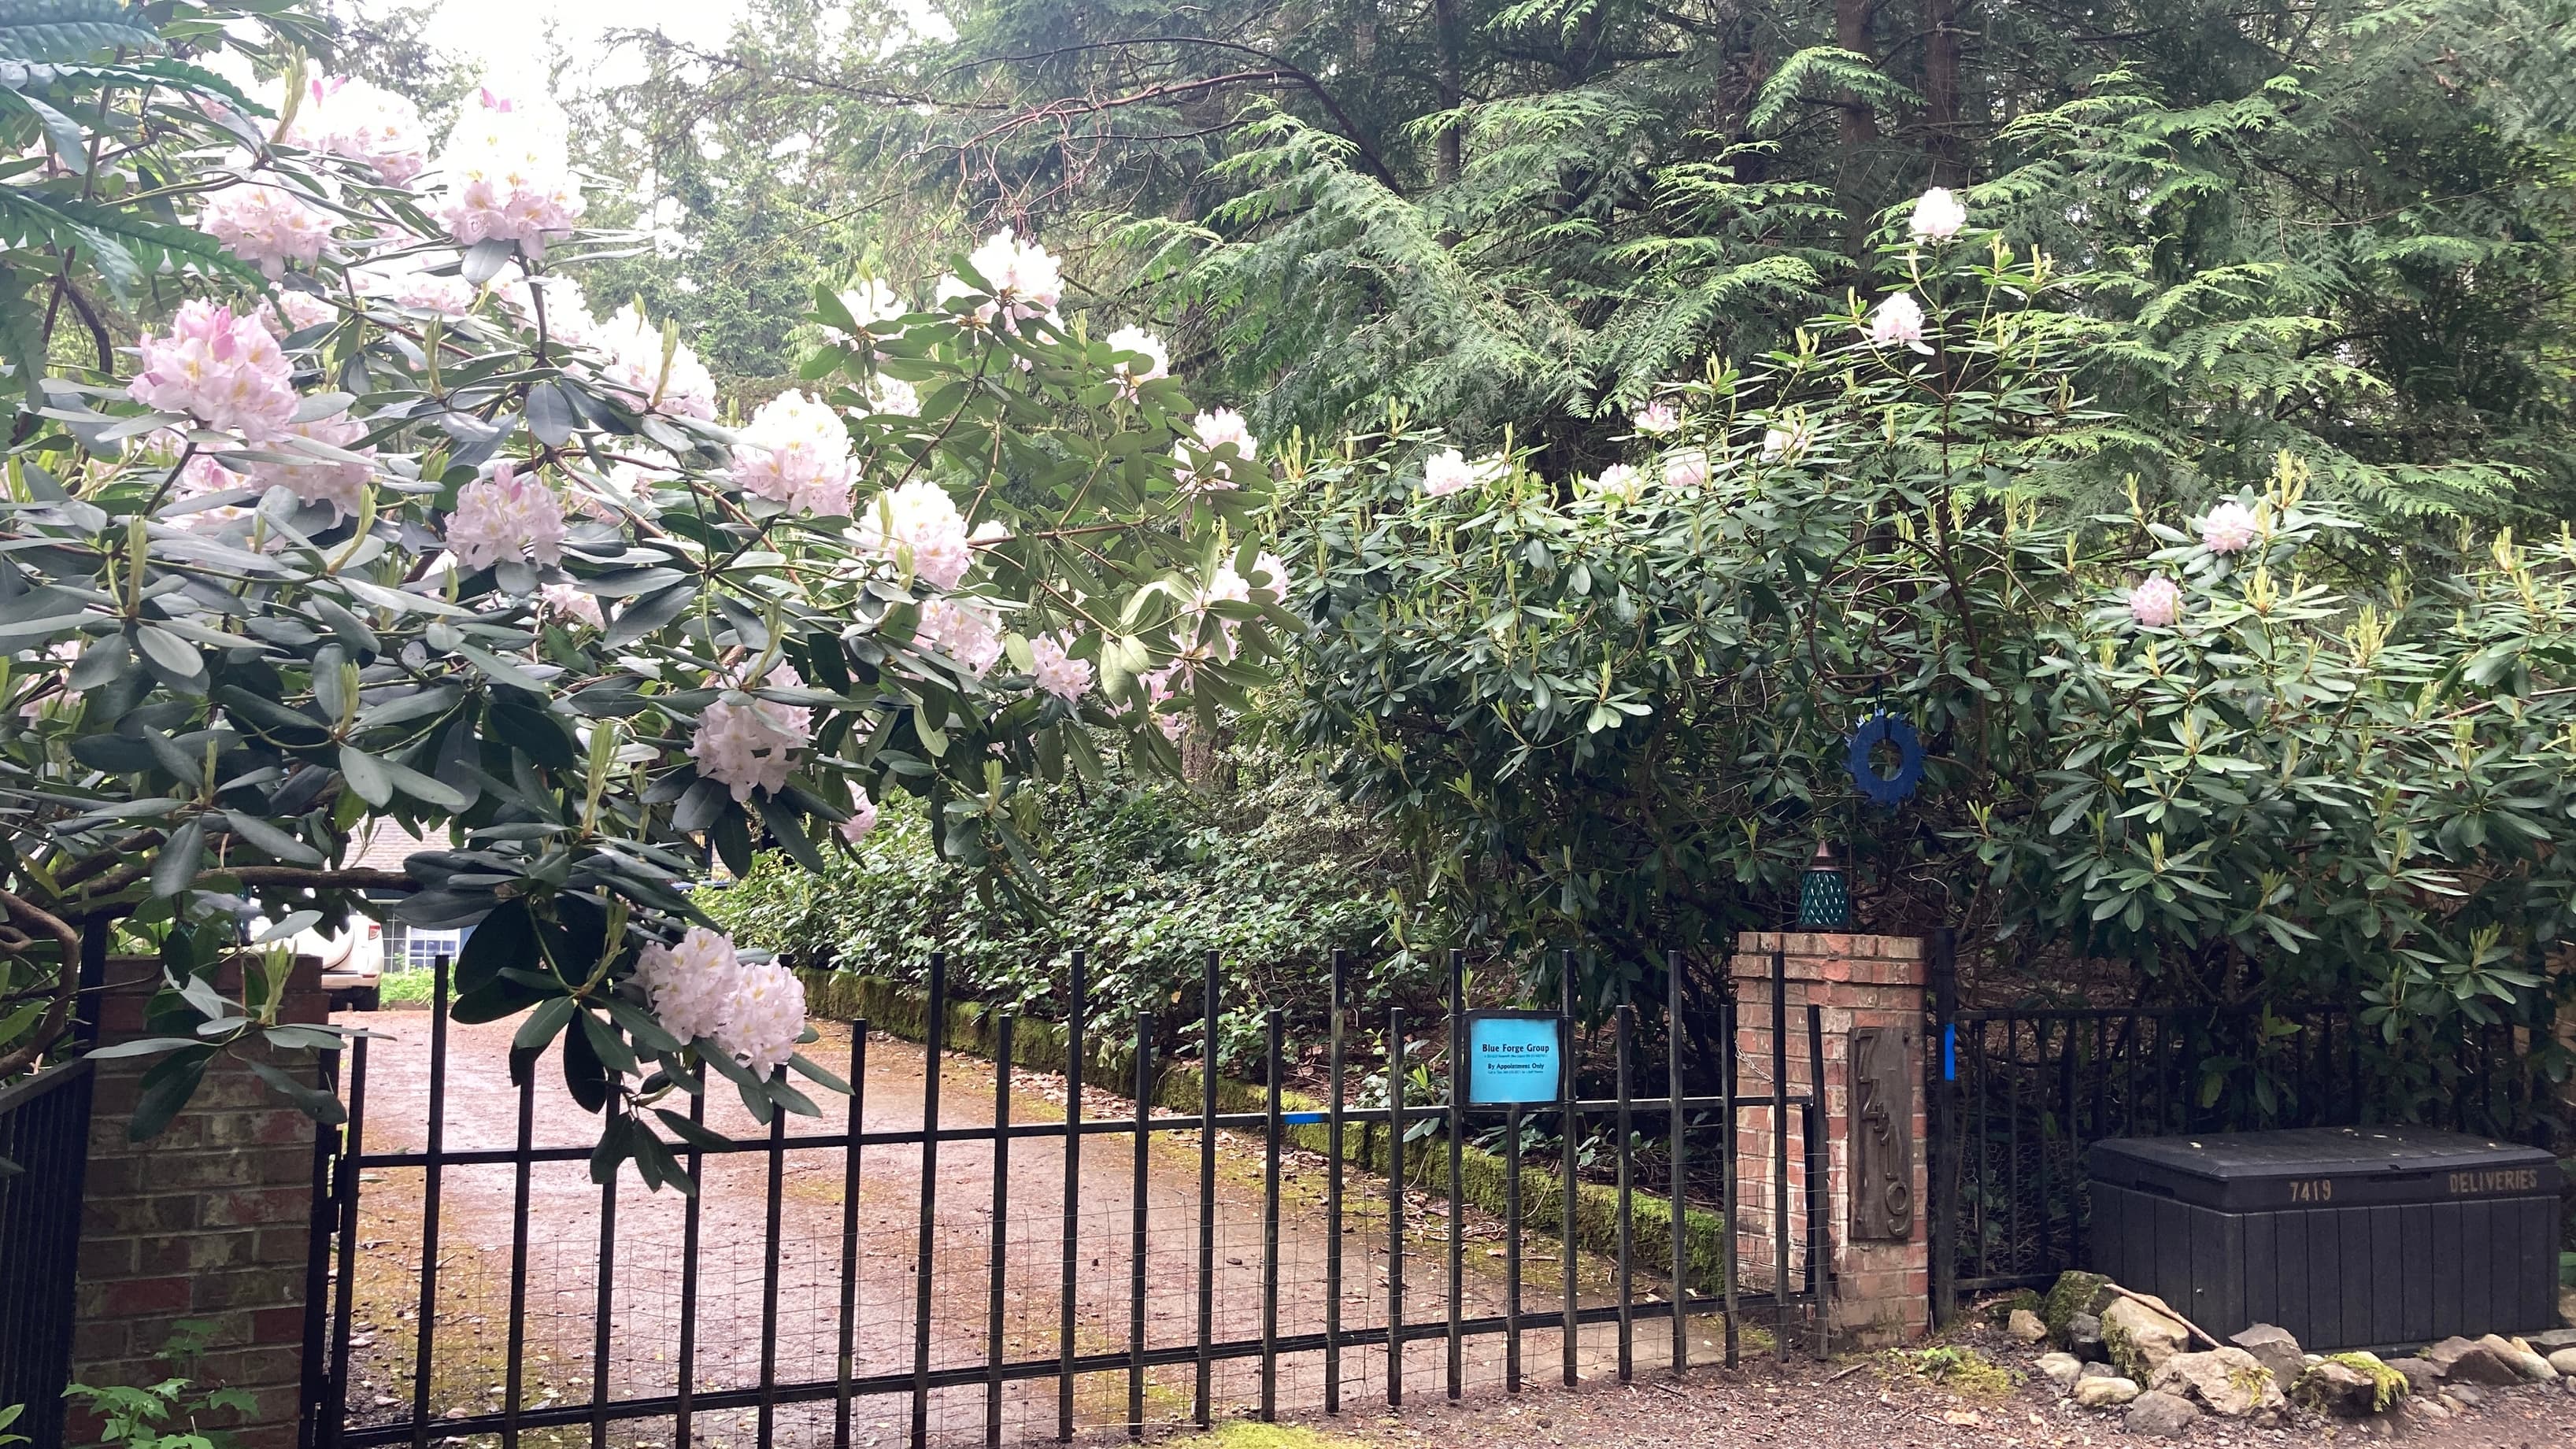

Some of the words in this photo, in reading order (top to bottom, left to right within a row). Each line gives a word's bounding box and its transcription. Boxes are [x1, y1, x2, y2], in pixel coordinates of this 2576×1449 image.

[1482, 1044, 1500, 1052] Blue
[1502, 1044, 1524, 1053] Forge
[1527, 1044, 1549, 1053] Group
[1854, 1027, 1910, 1236] 7419
[2289, 1179, 2331, 1203] 7419
[2449, 1169, 2537, 1193] DELIVERIES
